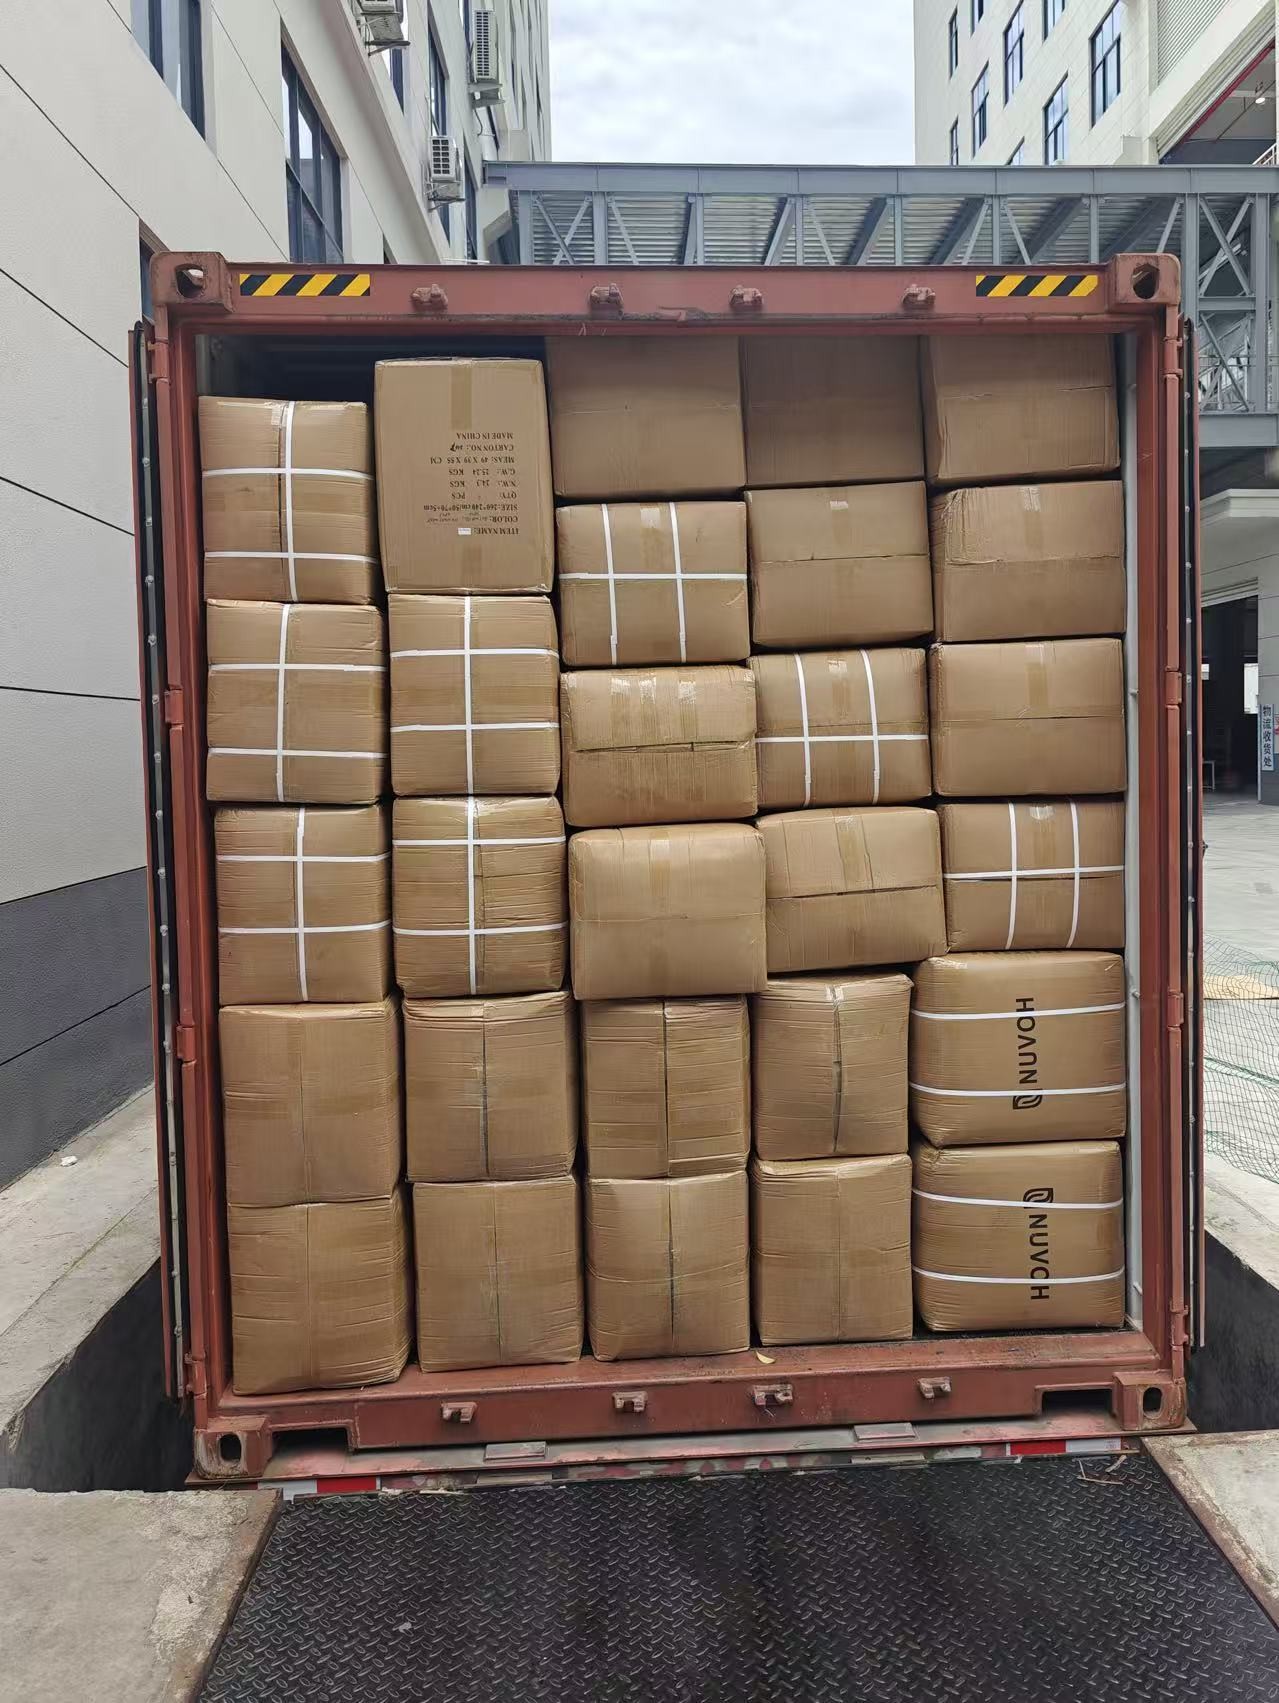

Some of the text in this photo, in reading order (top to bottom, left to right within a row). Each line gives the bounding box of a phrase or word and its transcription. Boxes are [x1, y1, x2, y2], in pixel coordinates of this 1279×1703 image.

[456, 432, 480, 440] CHINA
[452, 492, 465, 500] PCS
[1263, 705, 1272, 768] 物流收货处
[1016, 997, 1037, 1084] NUVOH
[1028, 1213, 1050, 1300] NUVOH
